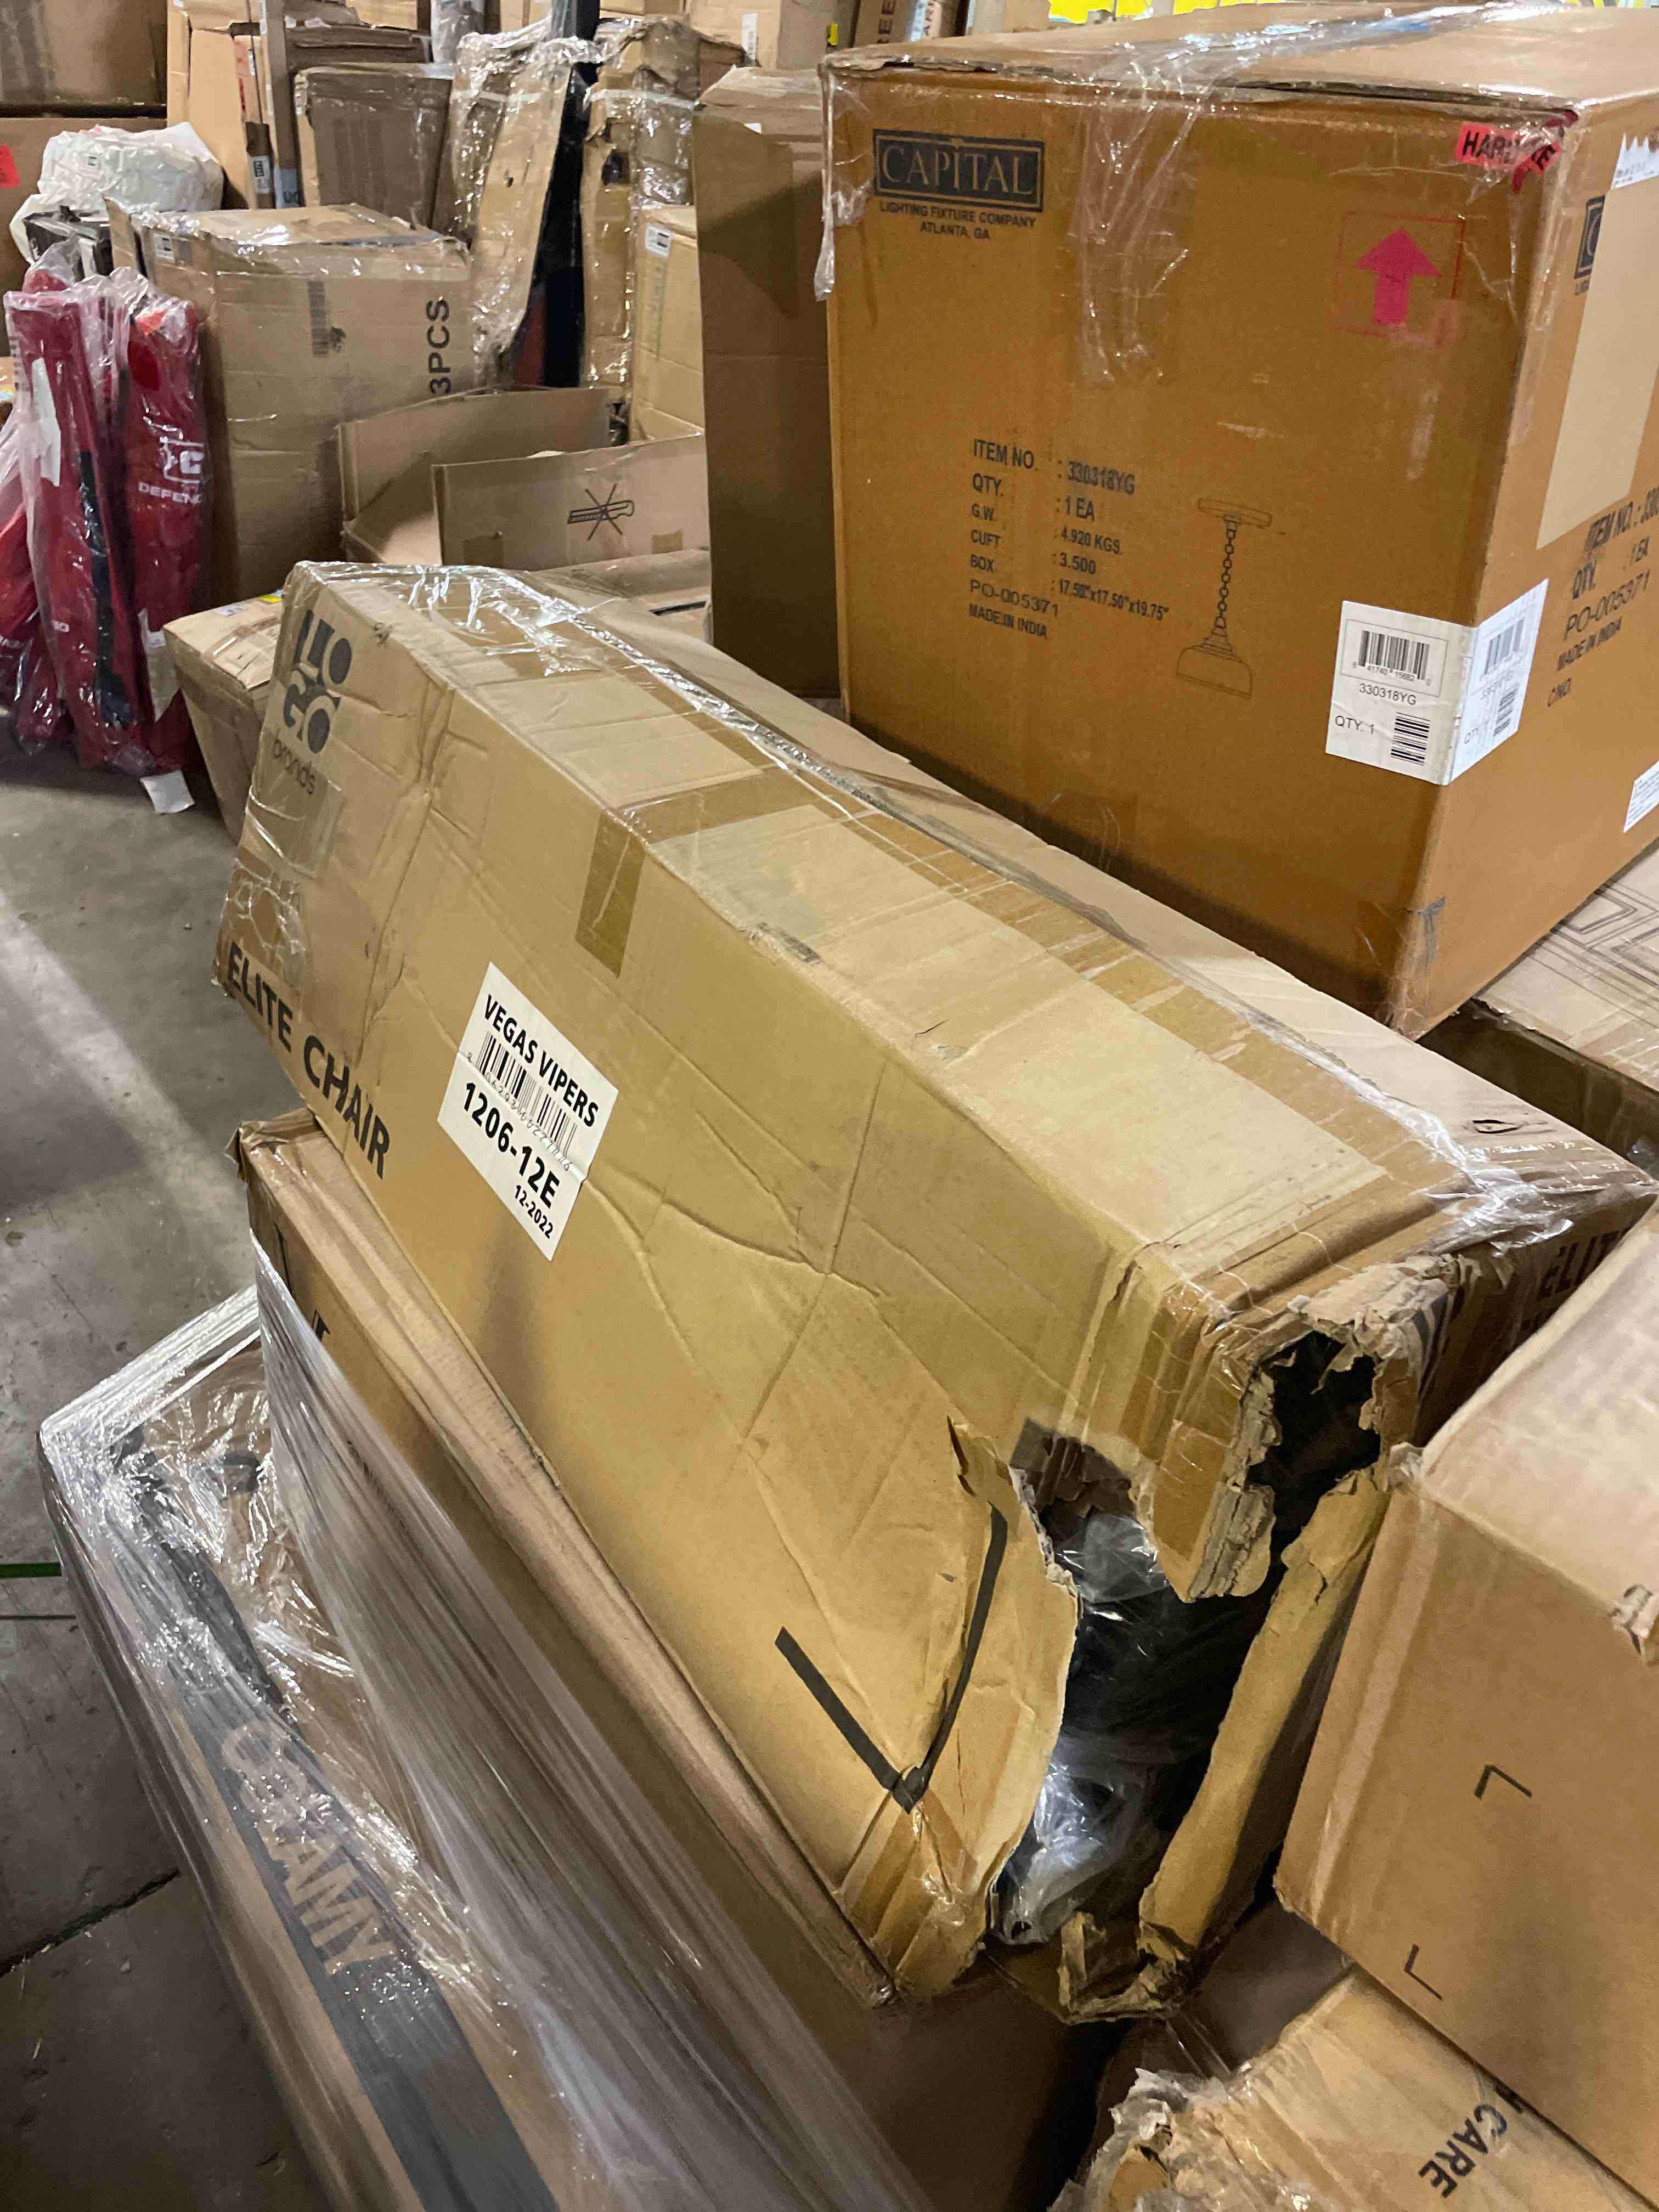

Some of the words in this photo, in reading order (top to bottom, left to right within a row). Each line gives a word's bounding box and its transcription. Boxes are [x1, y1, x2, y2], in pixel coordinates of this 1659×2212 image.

[881, 144, 1035, 195] CAPITAL
[879, 201, 928, 217] LIGHTING
[930, 206, 975, 223] FIXTURE
[979, 212, 1036, 229] COMPANY
[974, 228, 991, 240] GA
[426, 299, 452, 396] 3PCS
[973, 439, 1007, 465] ITEM
[1067, 461, 1136, 495] 330318YG
[1065, 495, 1071, 515] 1
[1076, 498, 1096, 521] EA
[970, 529, 1001, 549] CUFT
[1059, 552, 1097, 574] 3.500
[1061, 527, 1091, 546] 4.920
[970, 554, 995, 573] BOX
[1018, 618, 1049, 641] INDIA
[1359, 683, 1417, 706] 330318YG
[1369, 724, 1374, 735] 1
[227, 941, 294, 1053] ELITE
[303, 1035, 391, 1180] CHAIR
[484, 994, 538, 1063] VEGAS
[539, 1051, 599, 1127] VIPERS
[464, 1082, 560, 1209] 1206-12E
[515, 1184, 554, 1239] 12-2022
[1538, 1227, 1633, 1301] ELIT
[1418, 2104, 1507, 2198] CARE
